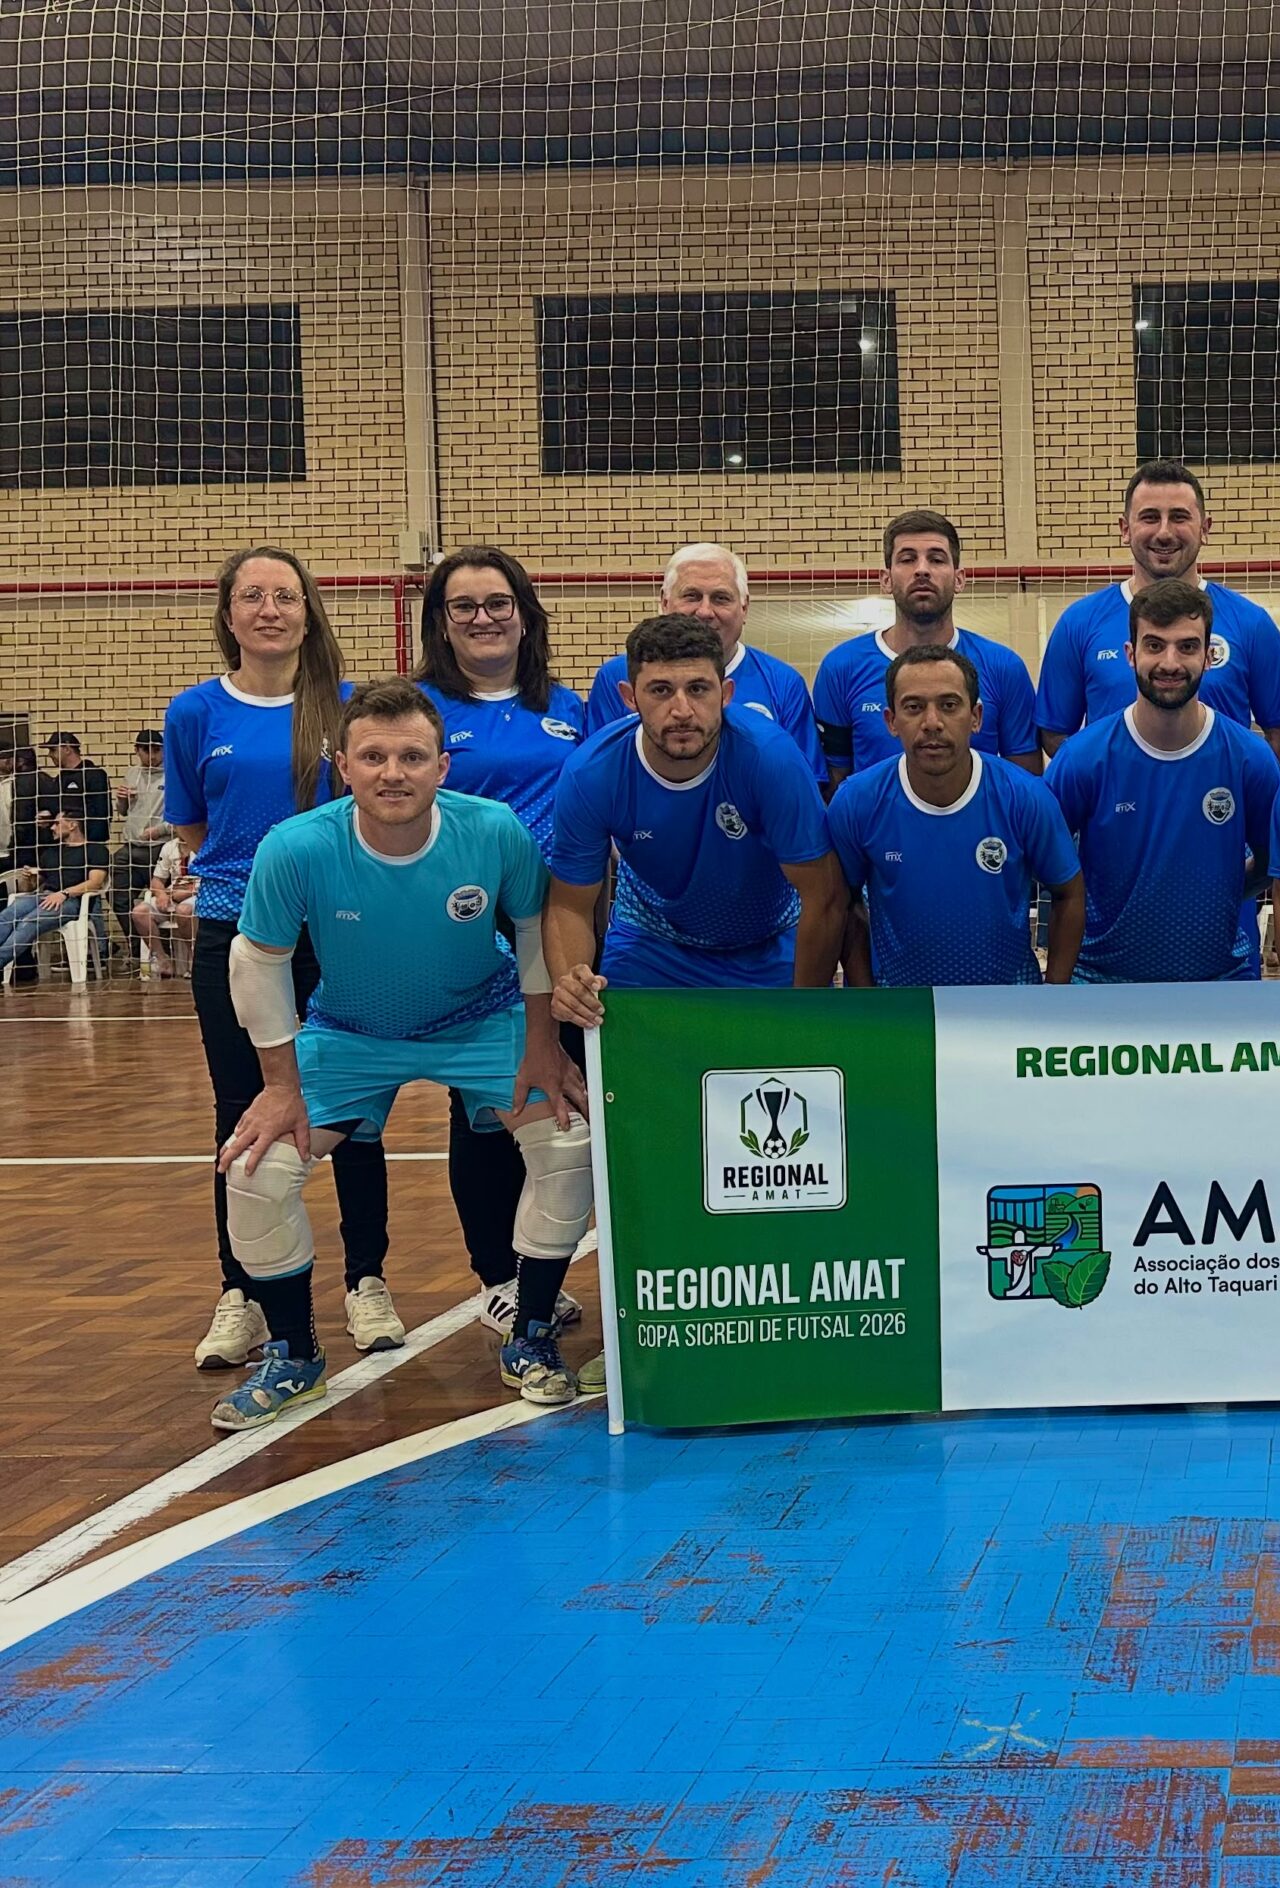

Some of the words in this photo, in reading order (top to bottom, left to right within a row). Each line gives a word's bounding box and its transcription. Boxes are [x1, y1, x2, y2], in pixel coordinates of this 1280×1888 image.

[1016, 1043, 1223, 1077] REGIONAL
[723, 1163, 829, 1189] REGIONAL
[752, 1189, 801, 1201] AMAT
[1133, 1254, 1241, 1275] Associação
[1246, 1252, 1280, 1270] dos
[636, 1263, 801, 1311] REGIONAL
[809, 1258, 906, 1302] AMAT
[1133, 1279, 1159, 1295] do
[1164, 1277, 1202, 1294] Alto
[1207, 1275, 1278, 1297] Taquari
[637, 1324, 680, 1348] COPA
[684, 1319, 755, 1346] SICREDI
[759, 1317, 782, 1342] DE
[787, 1314, 855, 1340] FUTSAL
[859, 1312, 906, 1337] 2026
